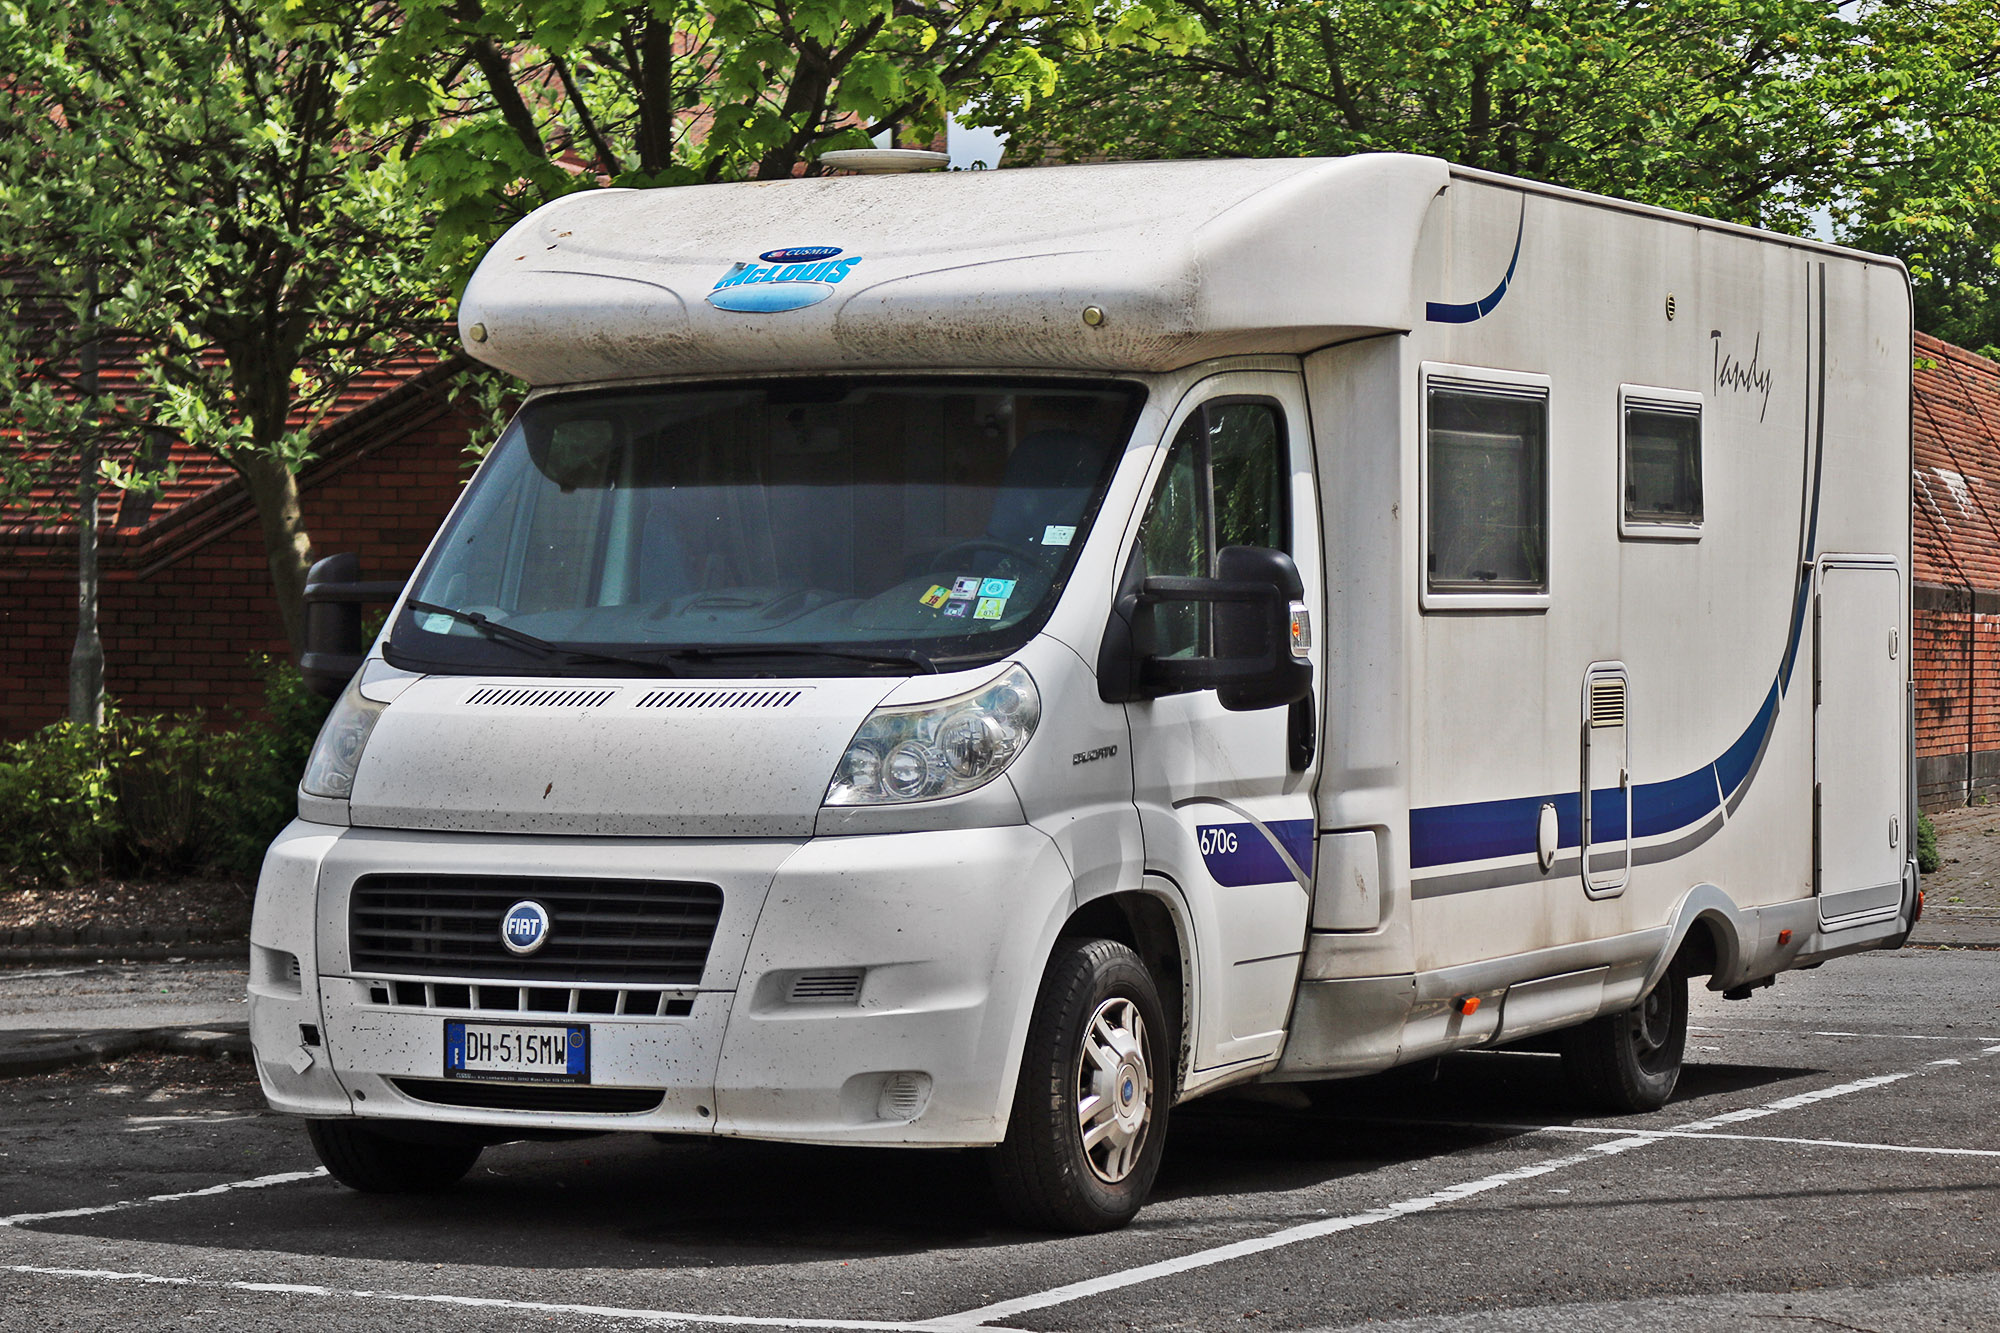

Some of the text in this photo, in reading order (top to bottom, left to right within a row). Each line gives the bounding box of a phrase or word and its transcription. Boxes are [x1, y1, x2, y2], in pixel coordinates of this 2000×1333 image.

[1711, 329, 1773, 424] Tandy
[1200, 828, 1238, 856] 670G
[507, 918, 540, 936] FIAT
